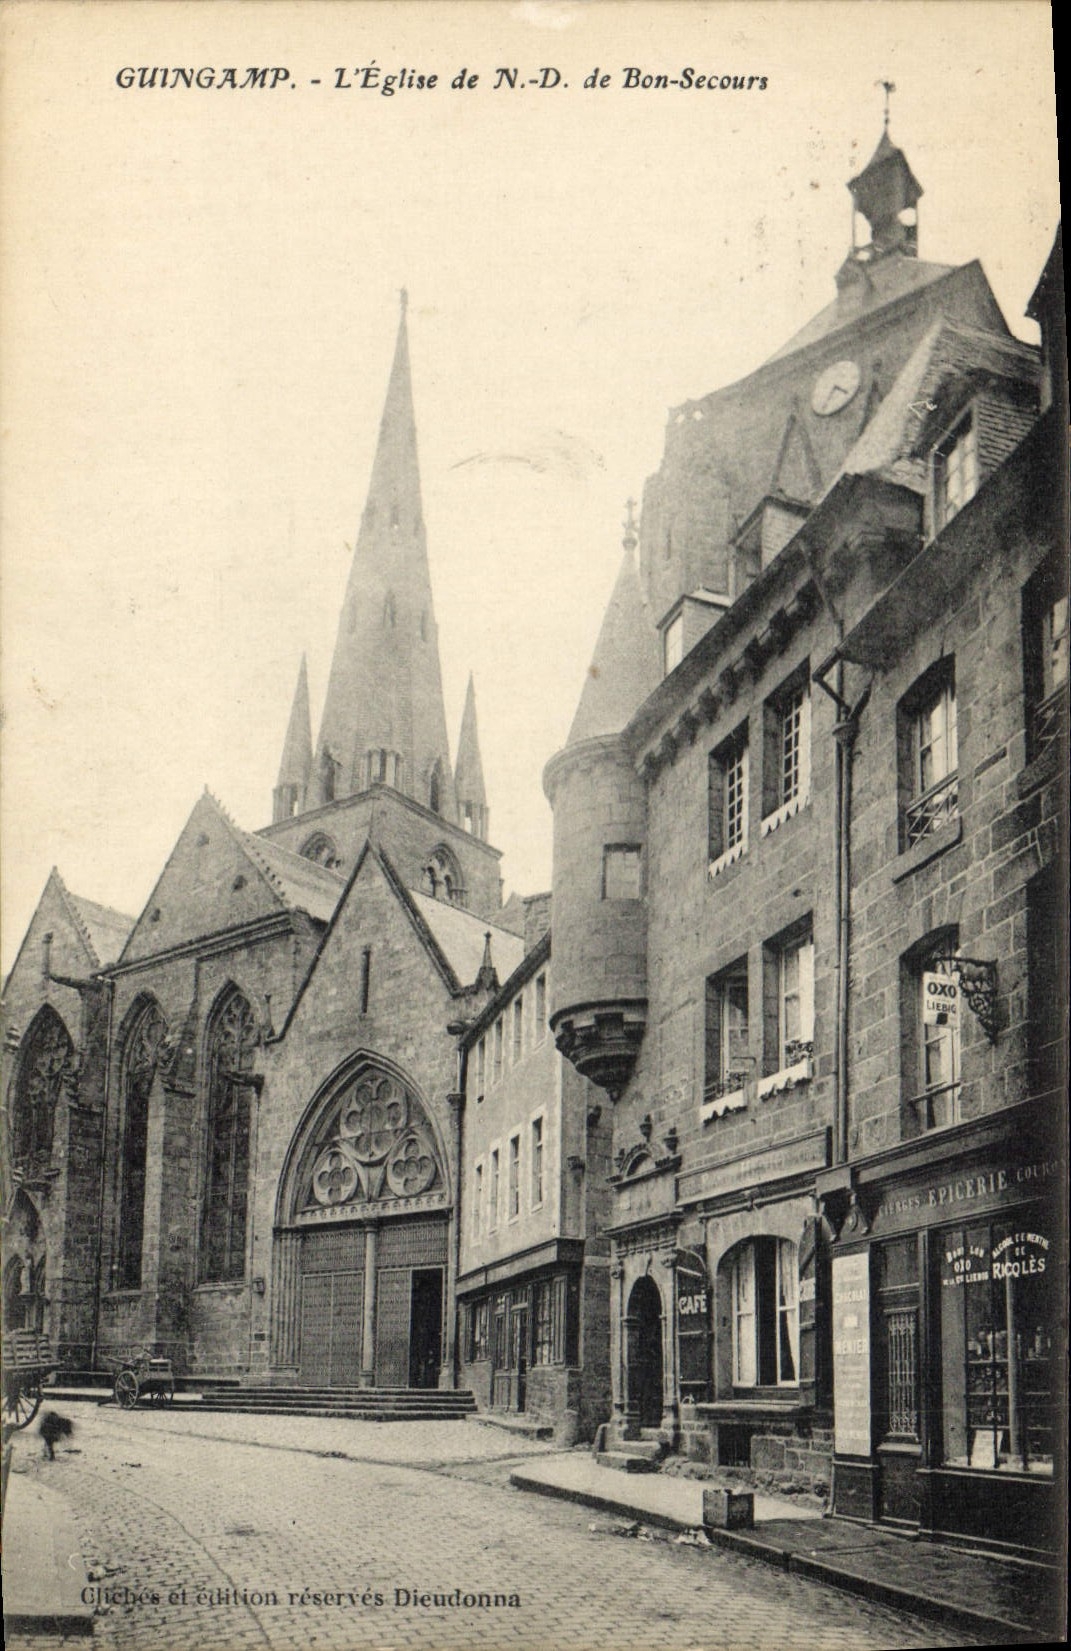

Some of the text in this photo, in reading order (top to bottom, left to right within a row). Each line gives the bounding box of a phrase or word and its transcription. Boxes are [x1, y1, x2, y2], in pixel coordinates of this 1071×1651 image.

[927, 982, 957, 998] OXO
[926, 1000, 956, 1014] LIEBIG
[928, 1170, 1008, 1207] EPICERIE
[992, 1254, 1046, 1280] RICQLÈS
[679, 1289, 707, 1315] CAFÉ
